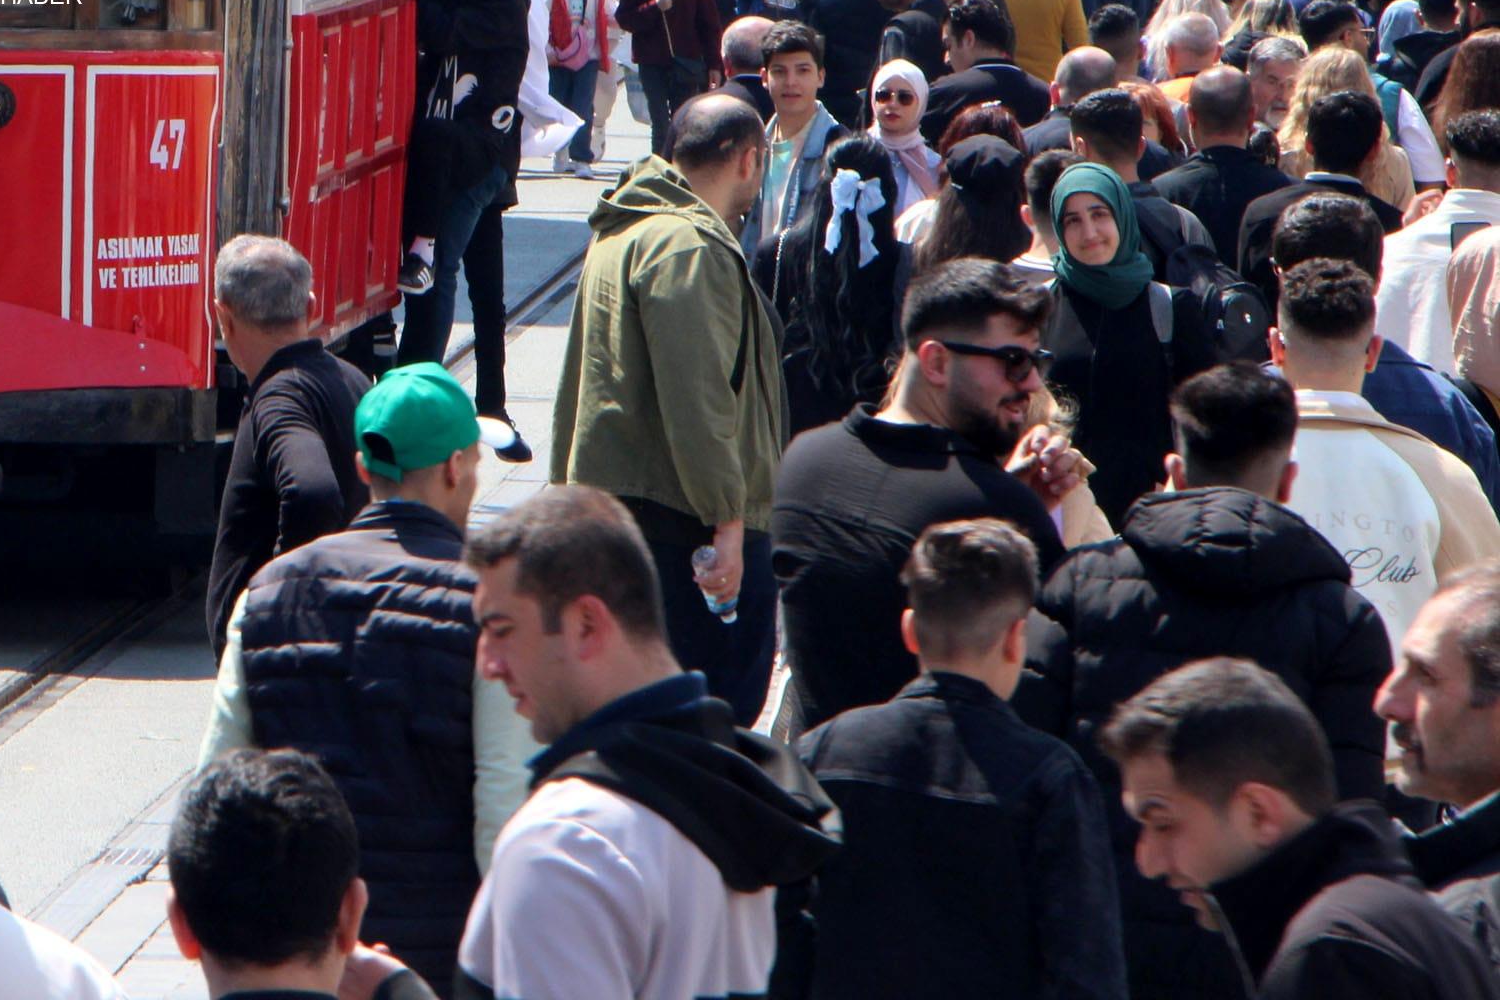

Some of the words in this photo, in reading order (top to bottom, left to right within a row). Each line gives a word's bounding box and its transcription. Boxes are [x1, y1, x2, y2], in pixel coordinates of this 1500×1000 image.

[150, 119, 186, 170] 47
[97, 236, 164, 260] ASILMAK
[167, 233, 200, 256] YASAK
[99, 268, 117, 289] VE
[122, 261, 199, 288] TEHLİKELİDİR
[1345, 547, 1420, 588] Club
